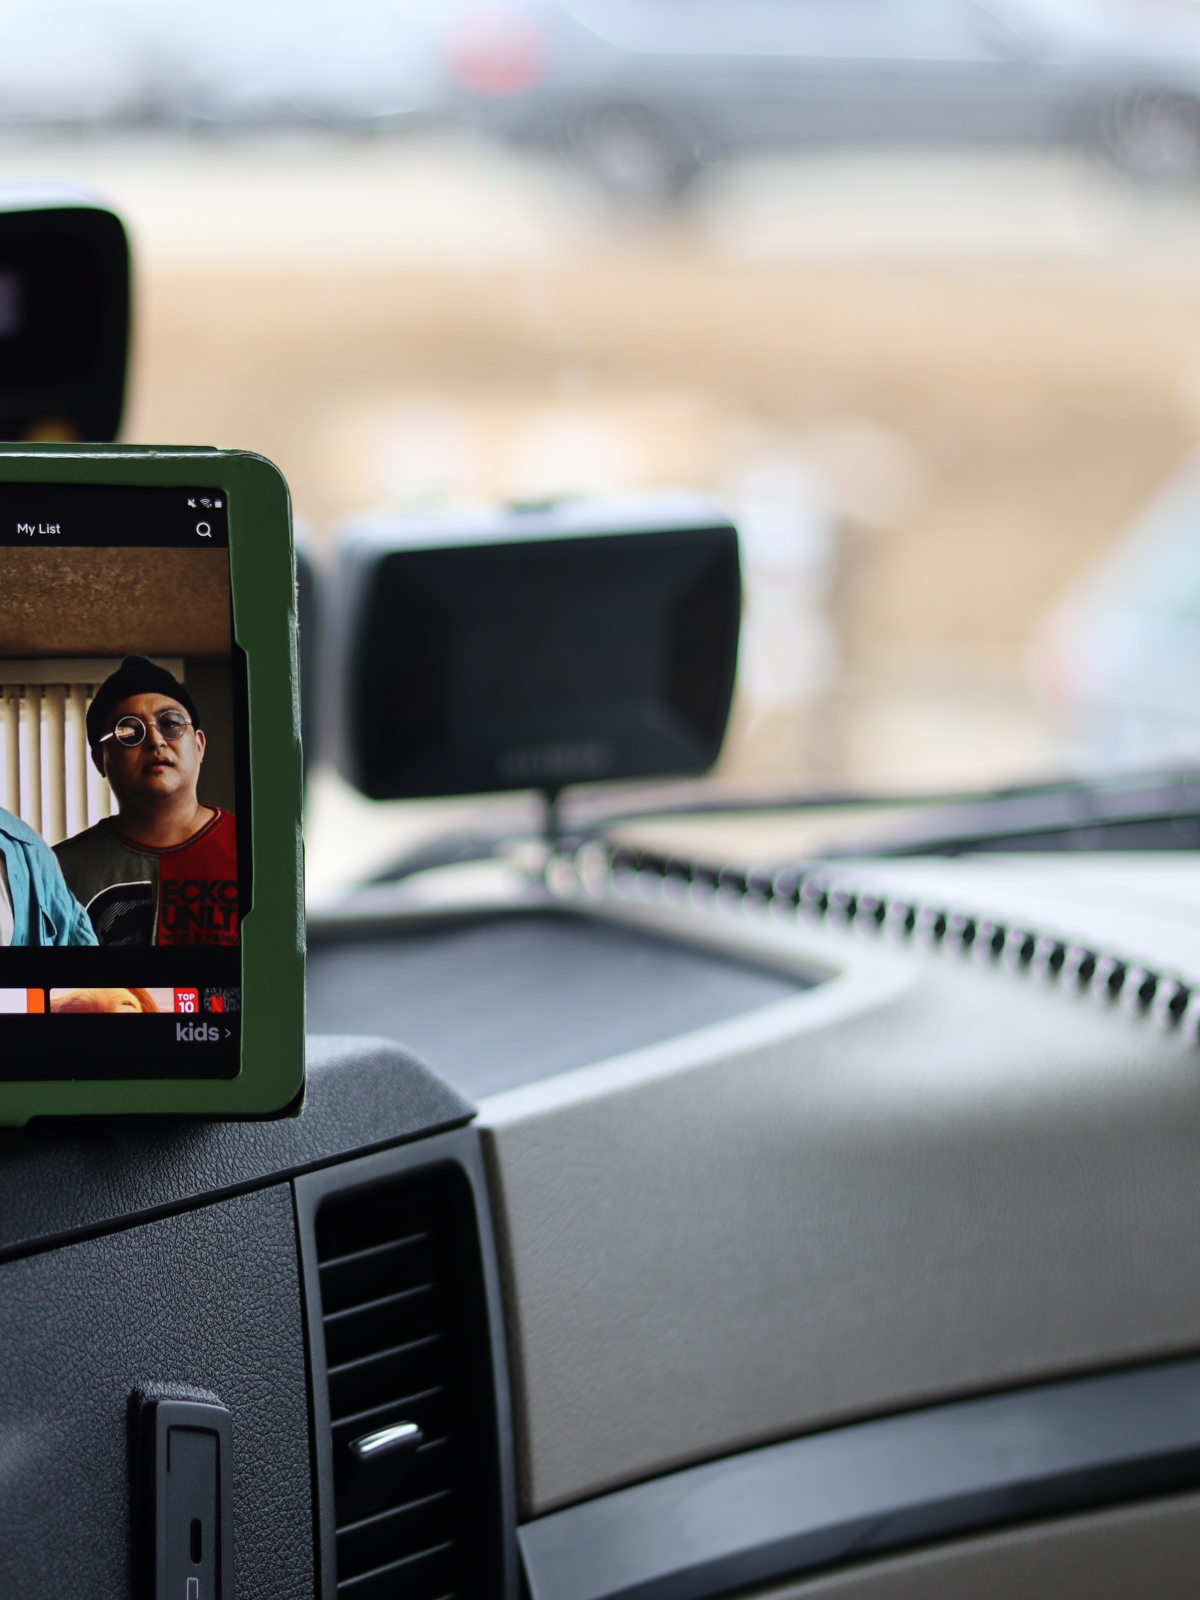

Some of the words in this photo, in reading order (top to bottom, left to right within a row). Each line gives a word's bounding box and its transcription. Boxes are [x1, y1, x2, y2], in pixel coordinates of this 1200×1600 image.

[18, 524, 35, 536] My
[39, 524, 60, 534] List
[162, 905, 239, 932] UNLT
[177, 994, 195, 1002] TOP
[179, 1002, 194, 1013] 10
[176, 1022, 219, 1041] kids
